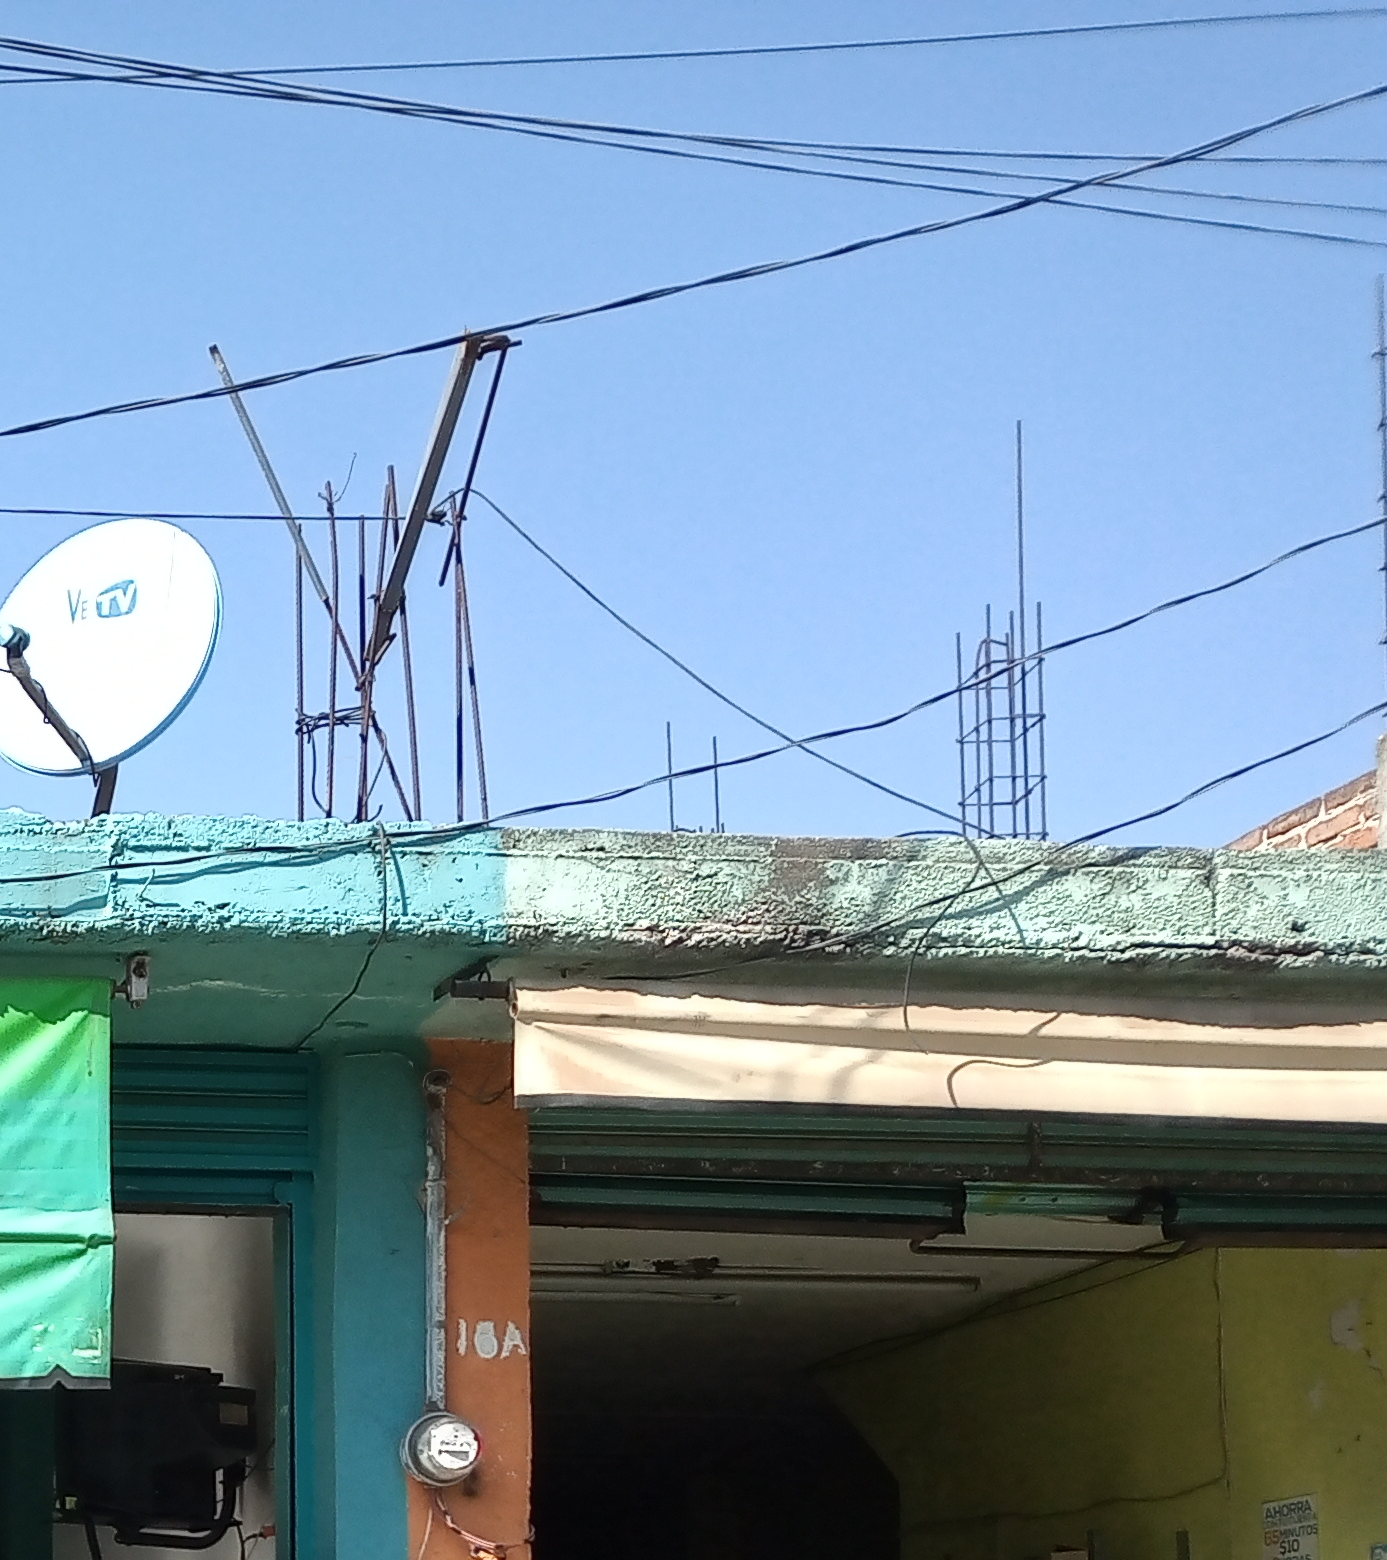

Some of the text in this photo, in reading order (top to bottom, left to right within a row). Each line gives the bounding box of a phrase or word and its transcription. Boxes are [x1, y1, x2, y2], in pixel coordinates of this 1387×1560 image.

[96, 580, 137, 618] TV
[1265, 1500, 1312, 1519] AHORRA
[1280, 1523, 1318, 1539] MINUTOS
[1280, 1539, 1300, 1555] $10
